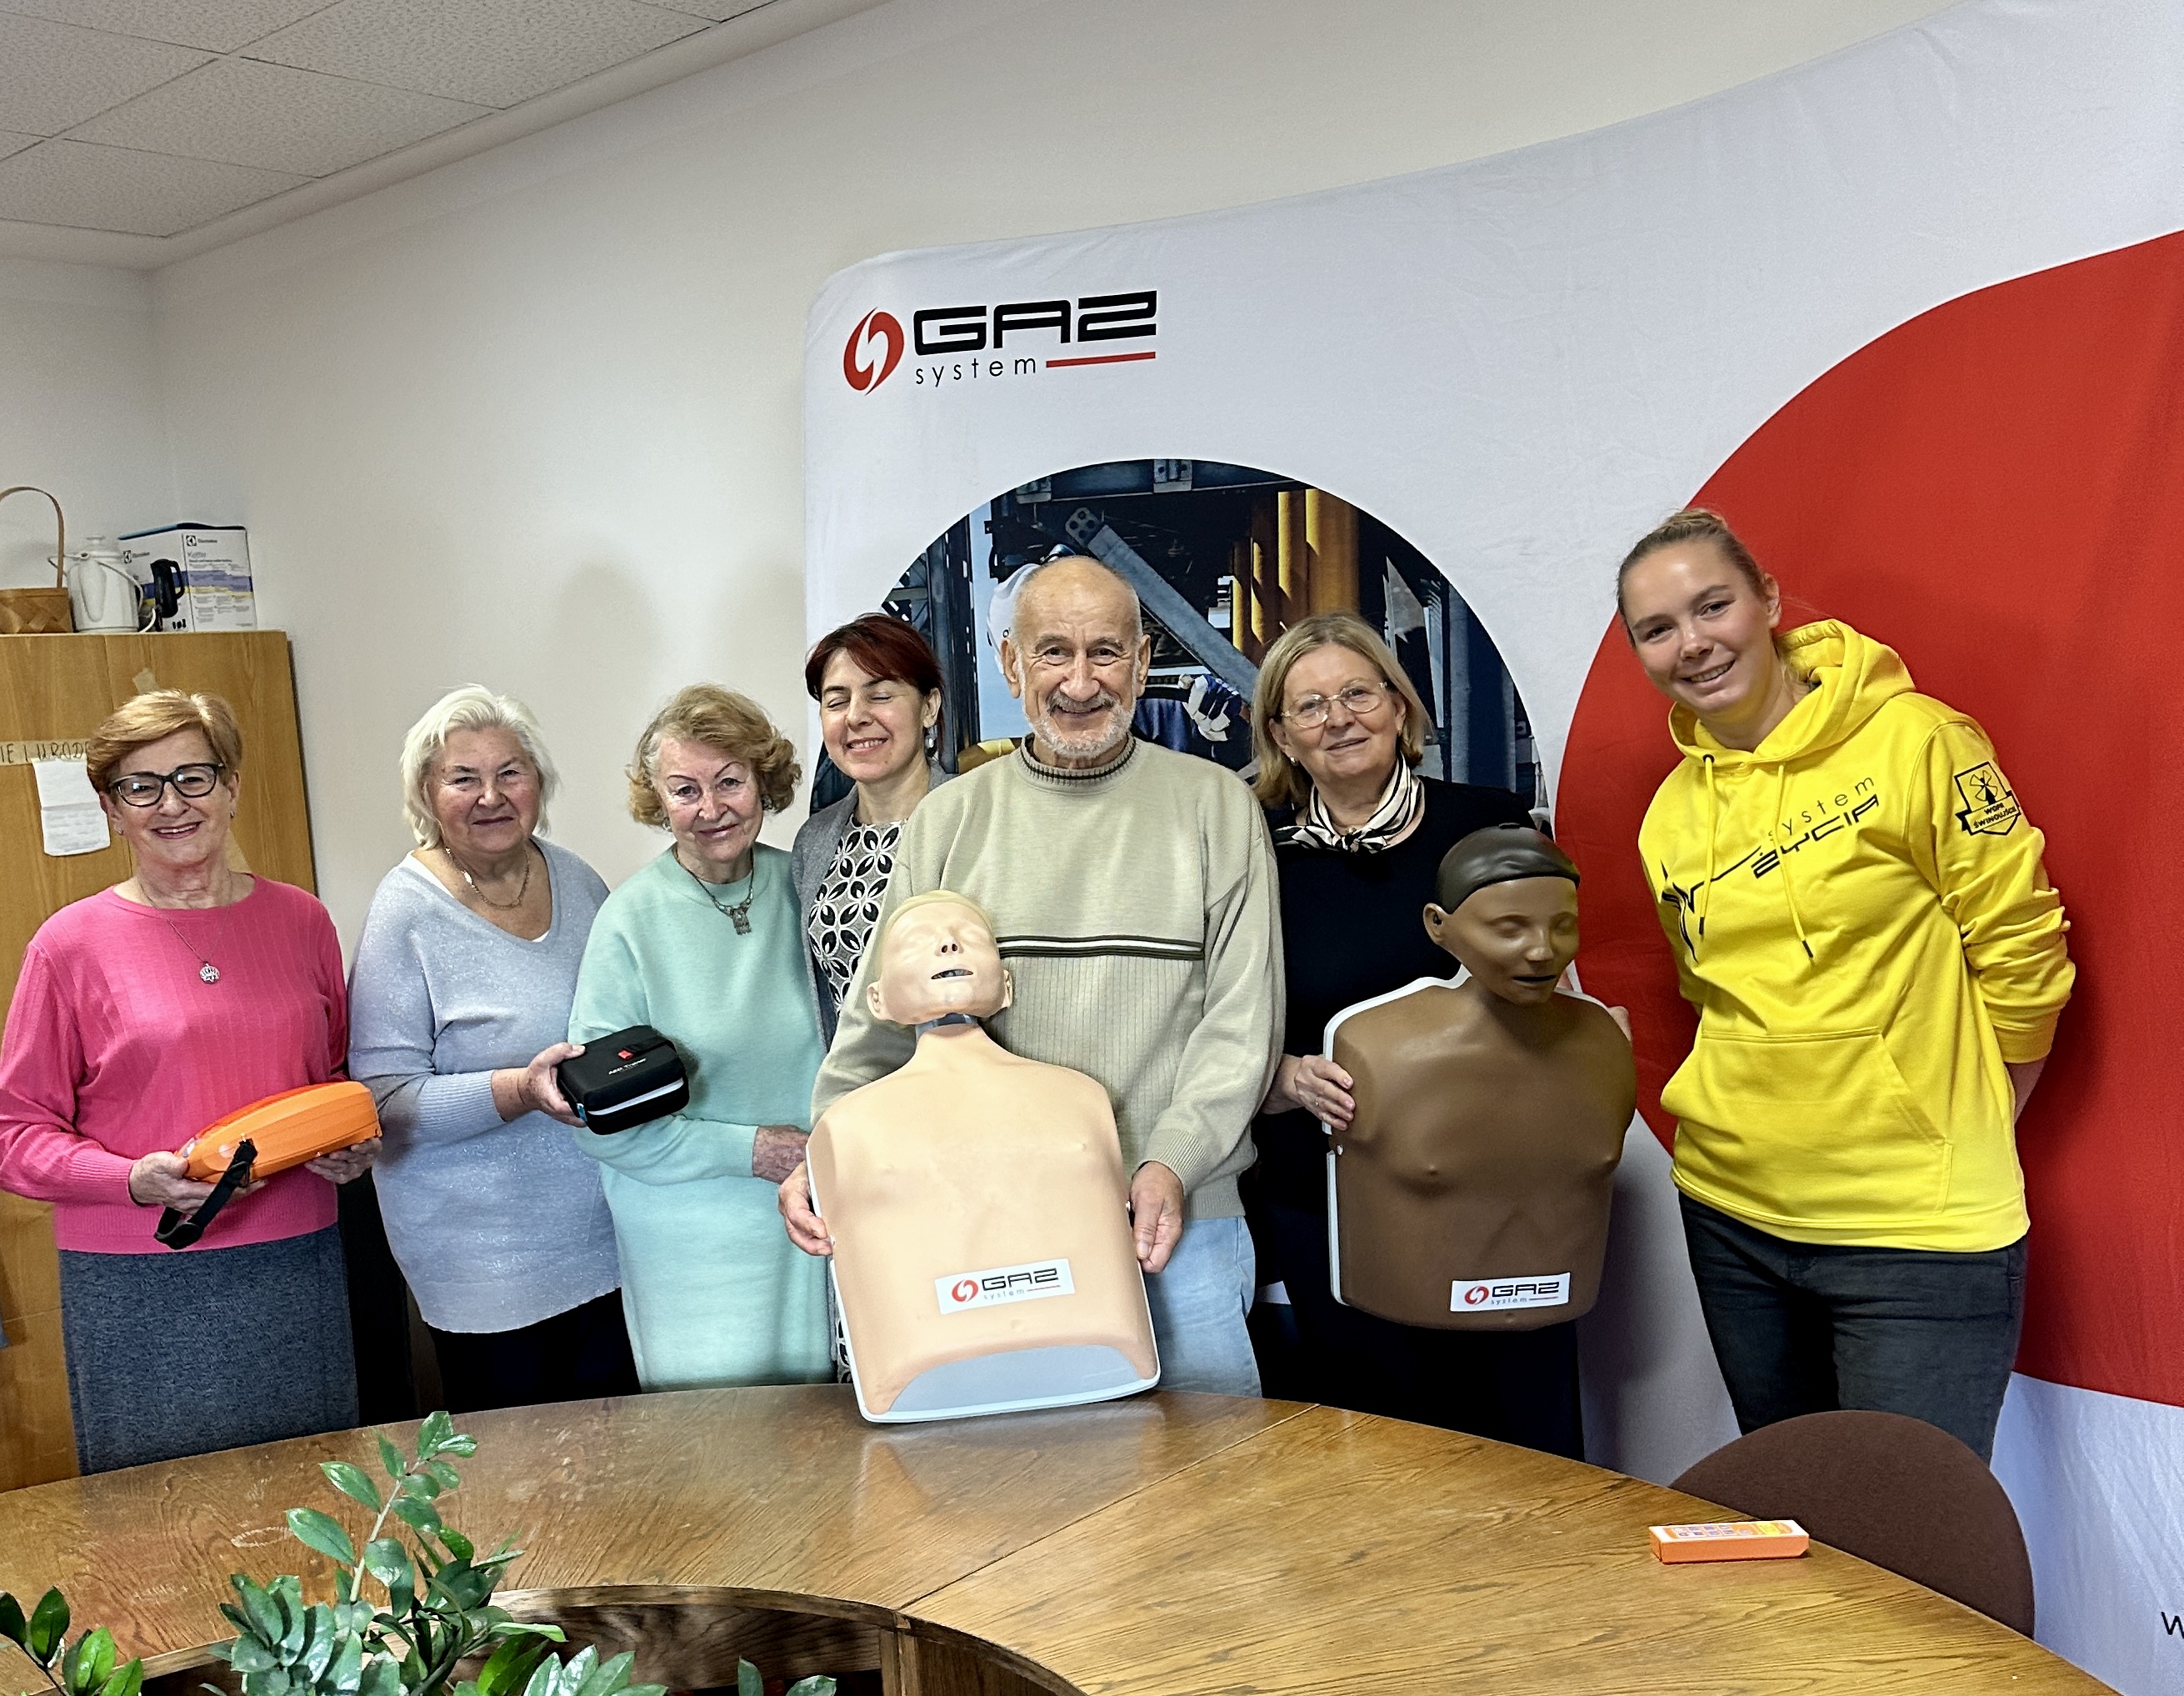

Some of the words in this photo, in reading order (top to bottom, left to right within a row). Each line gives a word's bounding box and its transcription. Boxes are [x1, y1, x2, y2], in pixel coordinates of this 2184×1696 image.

[913, 290, 1157, 356] GAZ
[916, 358, 1036, 388] system
[982, 1268, 1059, 1291] GAZ
[1492, 1281, 1560, 1298] GAZ
[983, 1288, 1025, 1301] system
[1491, 1298, 1527, 1306] system
